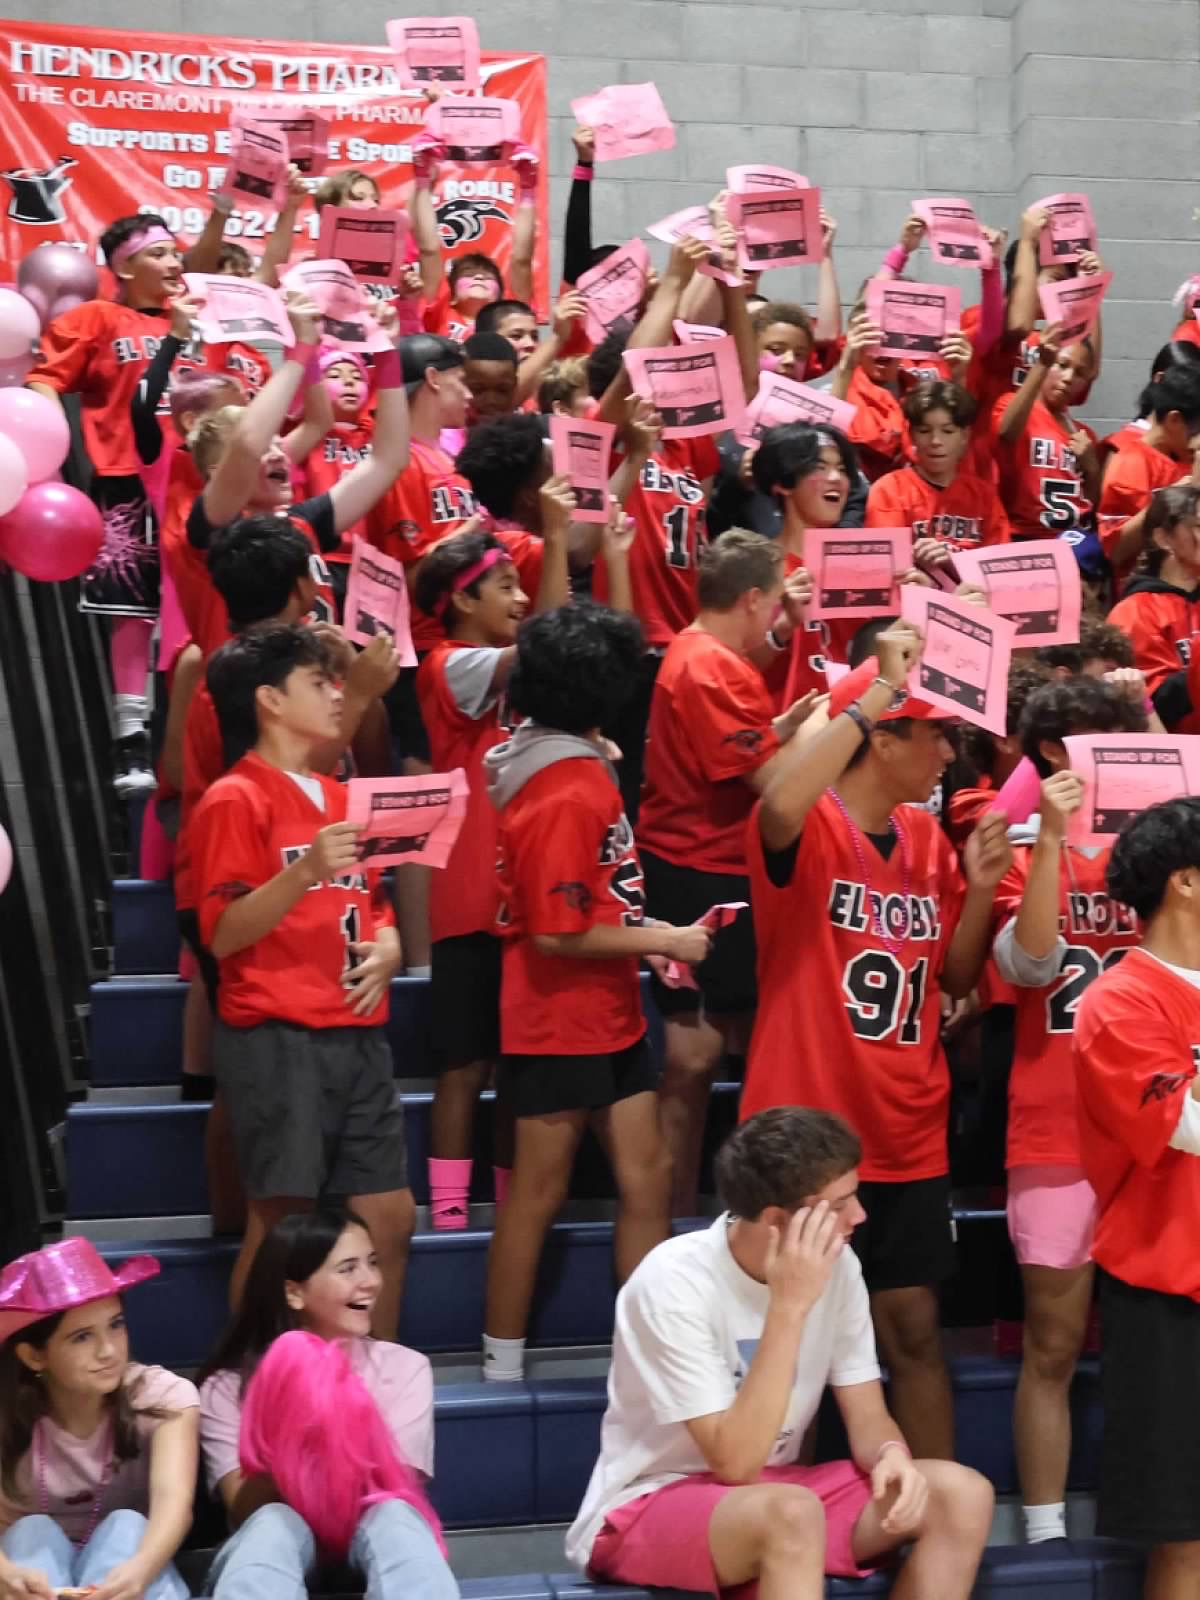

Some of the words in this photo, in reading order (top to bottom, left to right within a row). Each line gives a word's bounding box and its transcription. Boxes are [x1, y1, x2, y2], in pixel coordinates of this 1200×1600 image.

[8, 40, 256, 89] HENDRICKS
[12, 82, 65, 105] THE
[69, 87, 224, 114] CLAREMONT
[830, 879, 869, 932] EL
[842, 948, 929, 1044] 91
